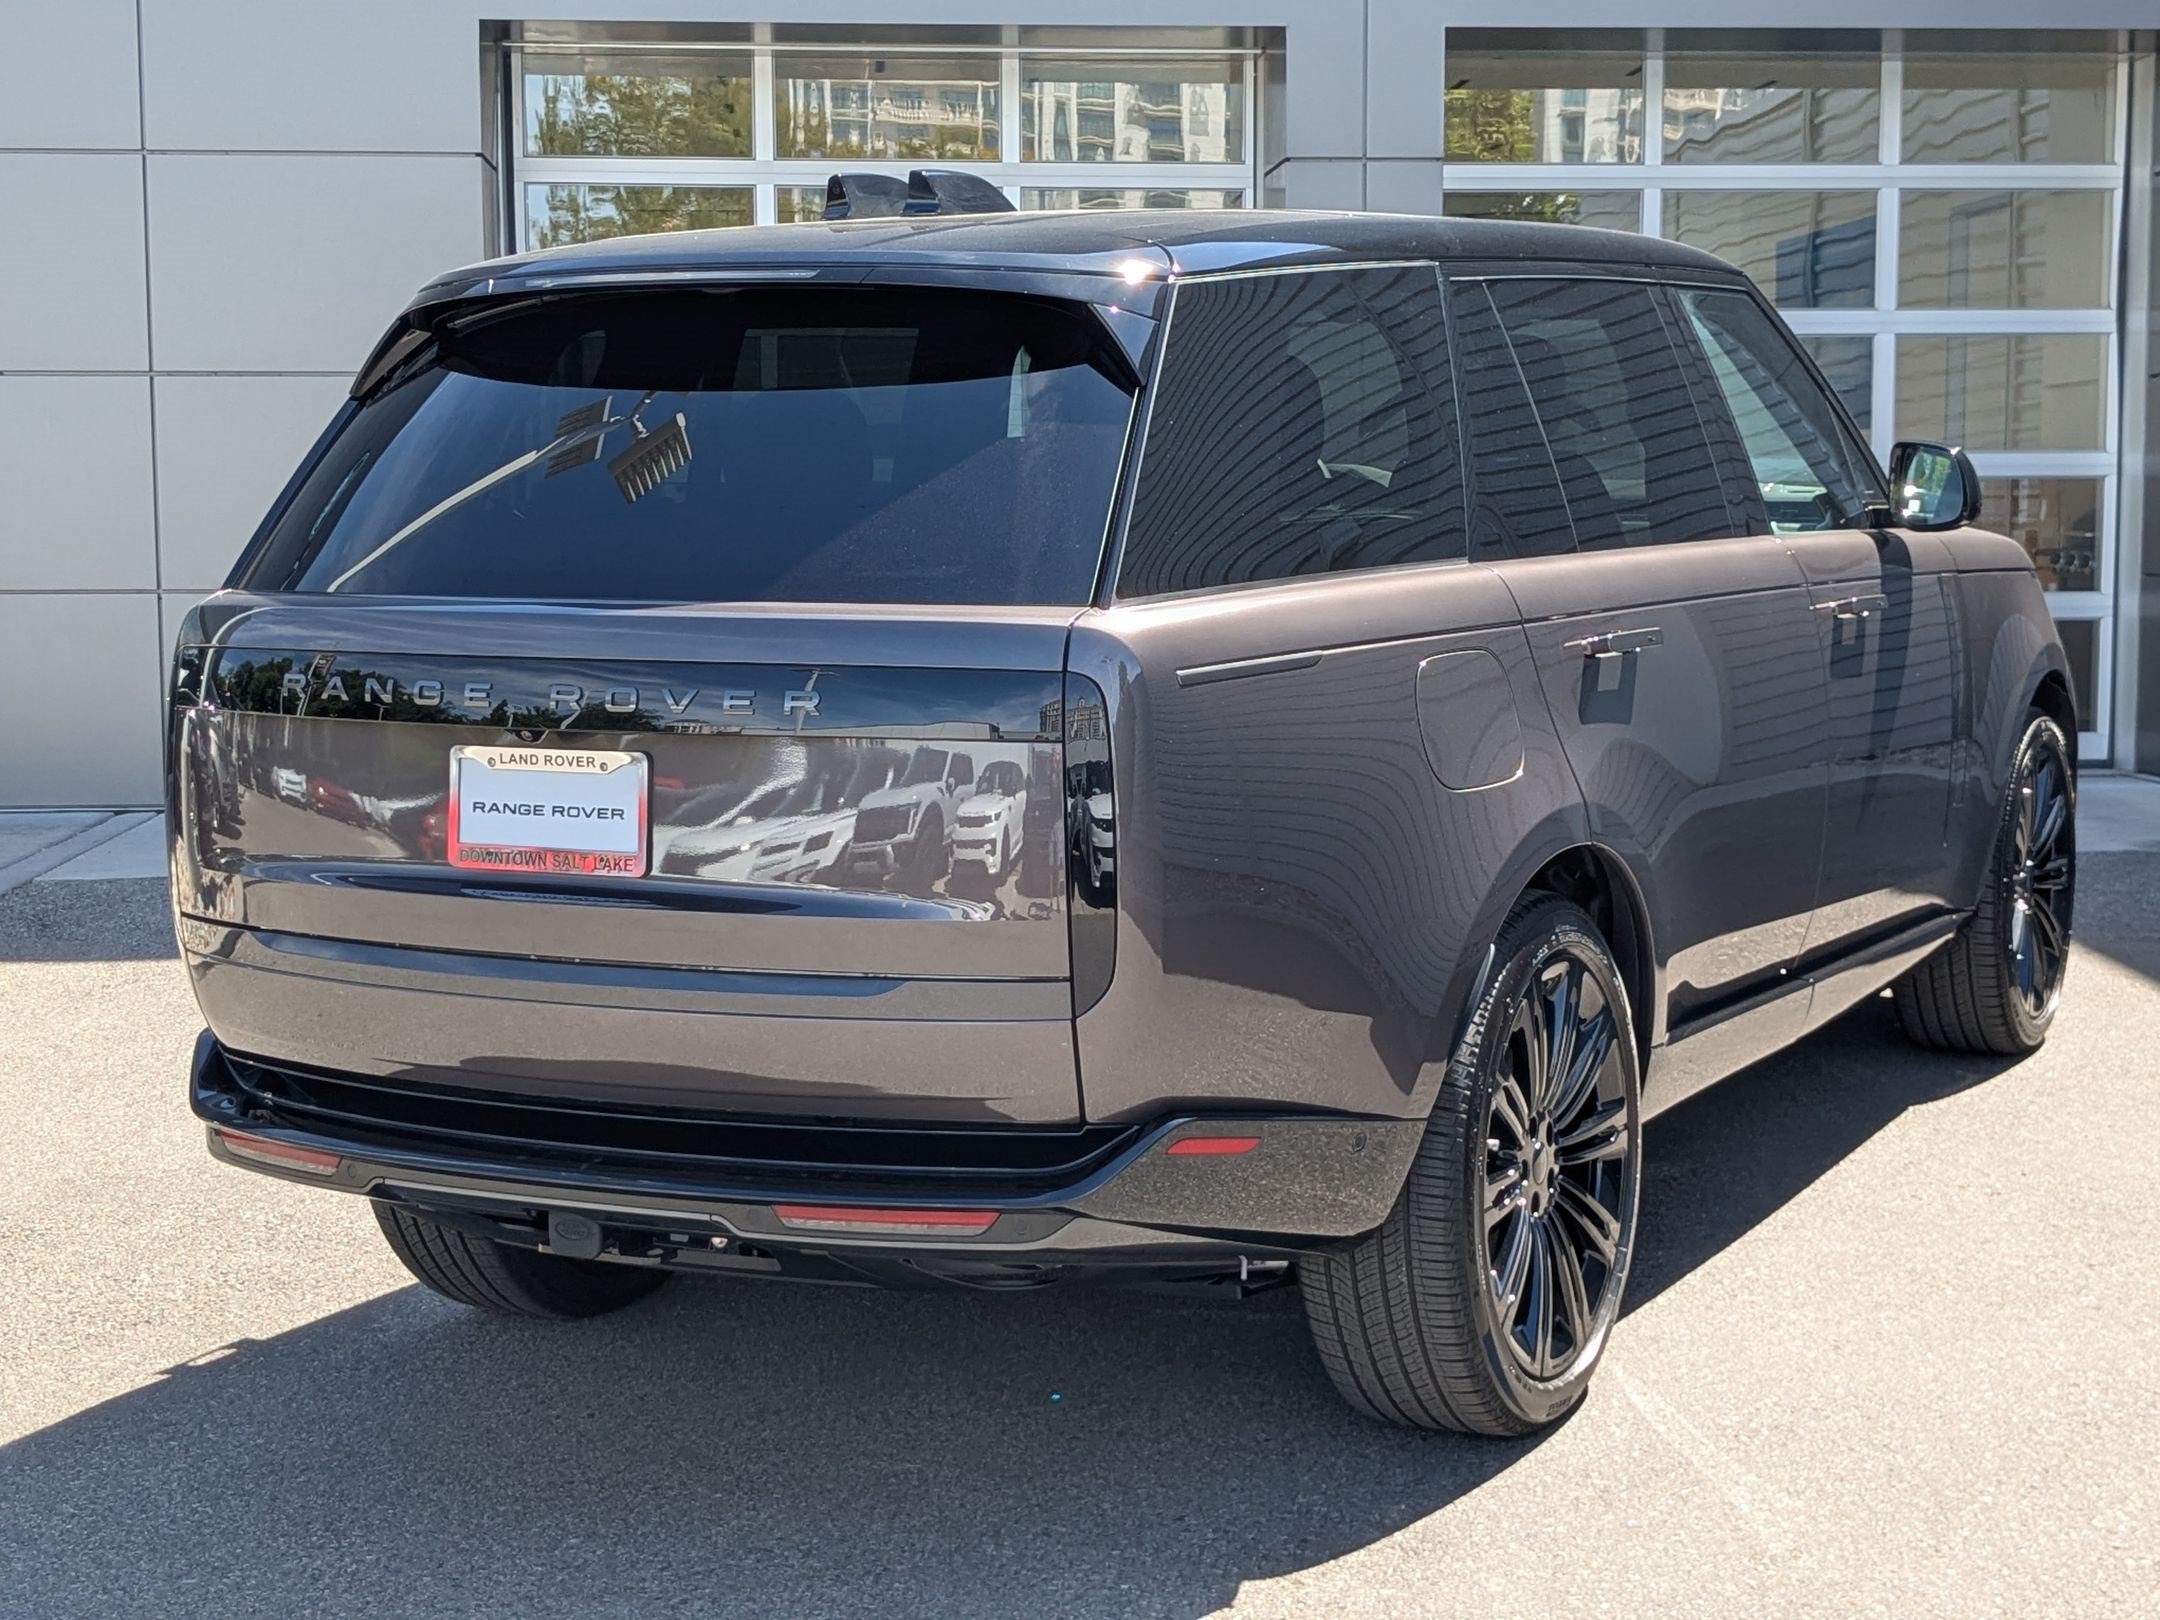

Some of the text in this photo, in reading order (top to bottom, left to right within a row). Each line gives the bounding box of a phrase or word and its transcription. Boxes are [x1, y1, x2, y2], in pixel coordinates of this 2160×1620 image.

[282, 673, 821, 716] RANGE ROVER
[499, 752, 597, 768] LAND ROVER
[472, 801, 625, 820] RANGE ROVER
[459, 848, 634, 872] DOWNTOWN SALT LAKE
